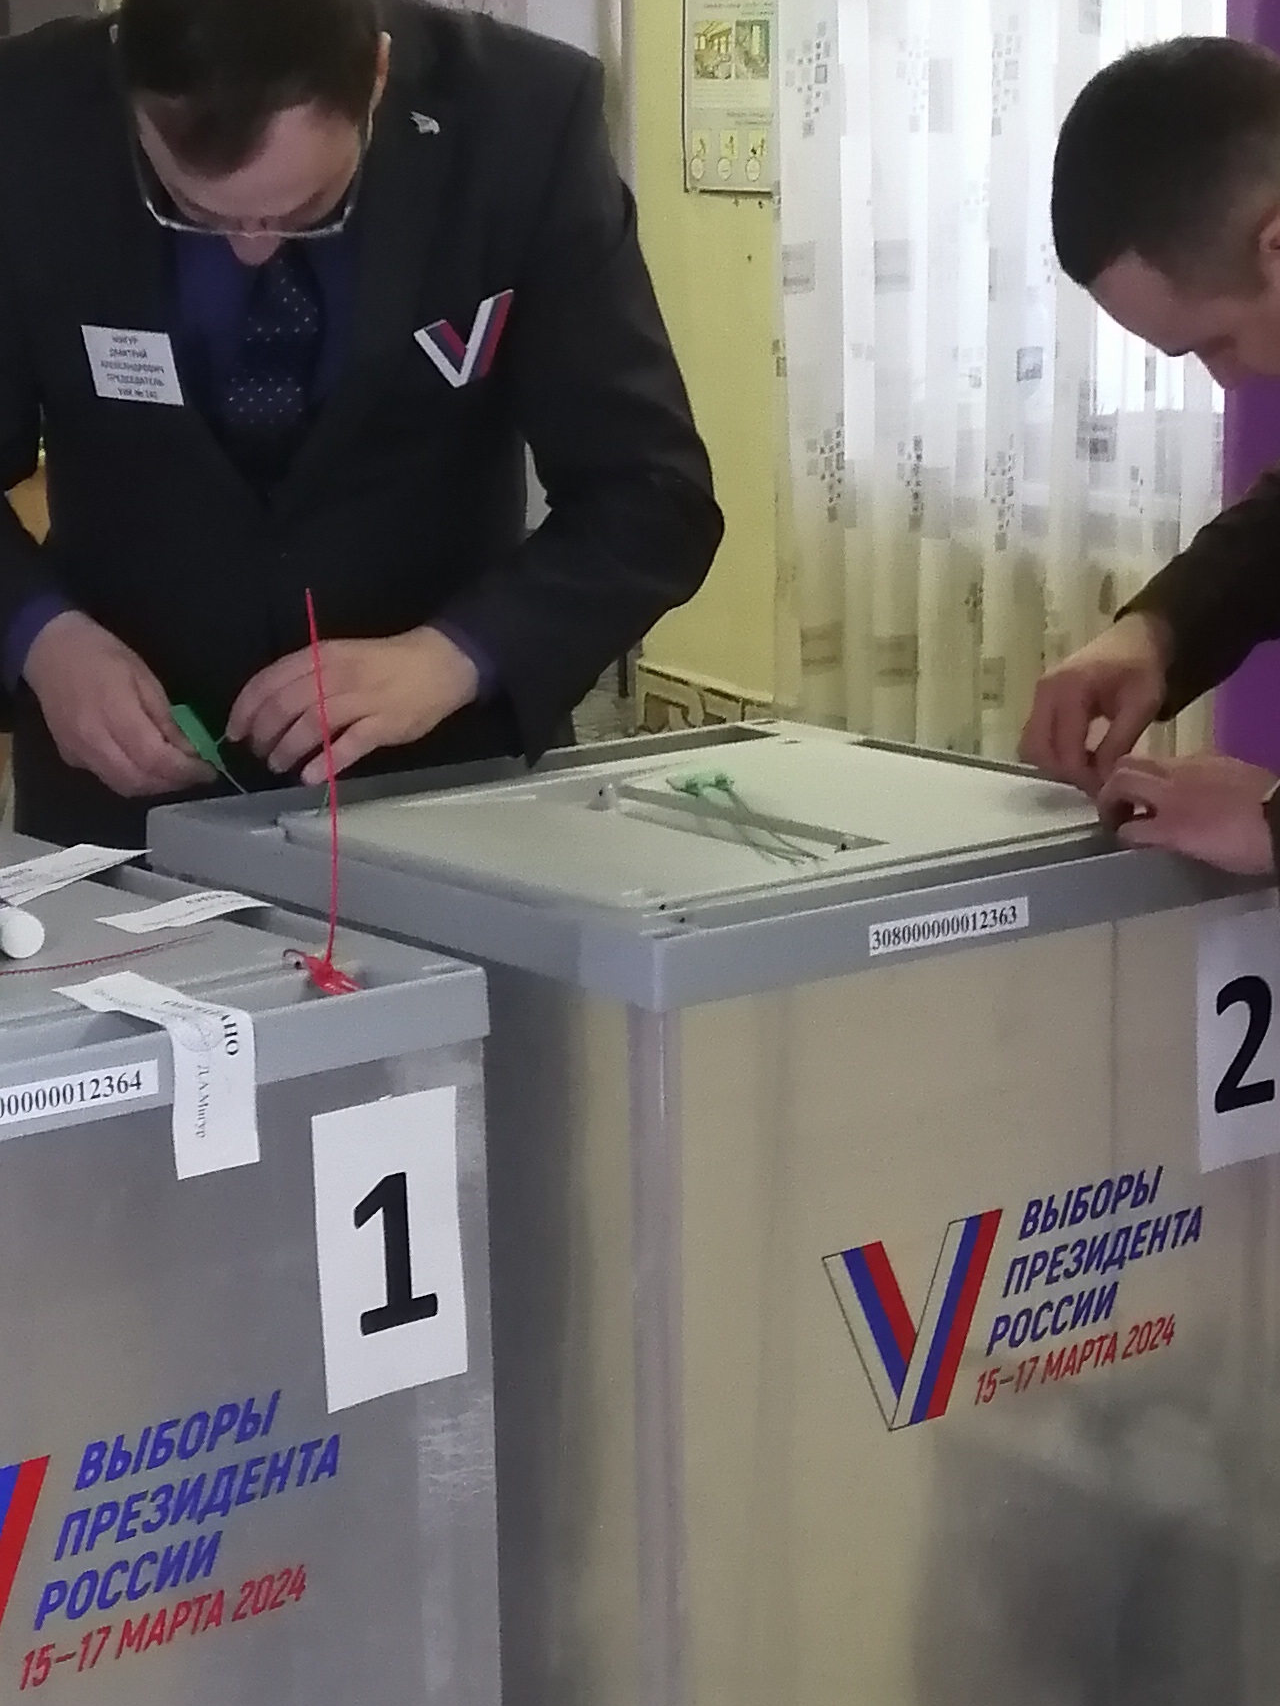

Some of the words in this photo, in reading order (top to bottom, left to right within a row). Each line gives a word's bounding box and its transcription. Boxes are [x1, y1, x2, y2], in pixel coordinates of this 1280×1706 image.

[872, 905, 1017, 950] 308000000012363
[1214, 975, 1276, 1114] 2
[1018, 1165, 1164, 1241] ВЫБОРЫ
[353, 1171, 438, 1336] 1
[1002, 1205, 1203, 1299] ПРЕЗИДЕНТА
[986, 1282, 1119, 1357] РОССИИ
[1041, 1331, 1118, 1385] МАРТА
[1121, 1314, 1175, 1360] 2024
[74, 1389, 282, 1491] ВЫБОРЫ
[54, 1433, 341, 1562] ПРЕЗИДЕНТА
[34, 1530, 223, 1631] РОССИИ
[115, 1589, 225, 1660] МАРТА
[231, 1564, 307, 1622] 2024
